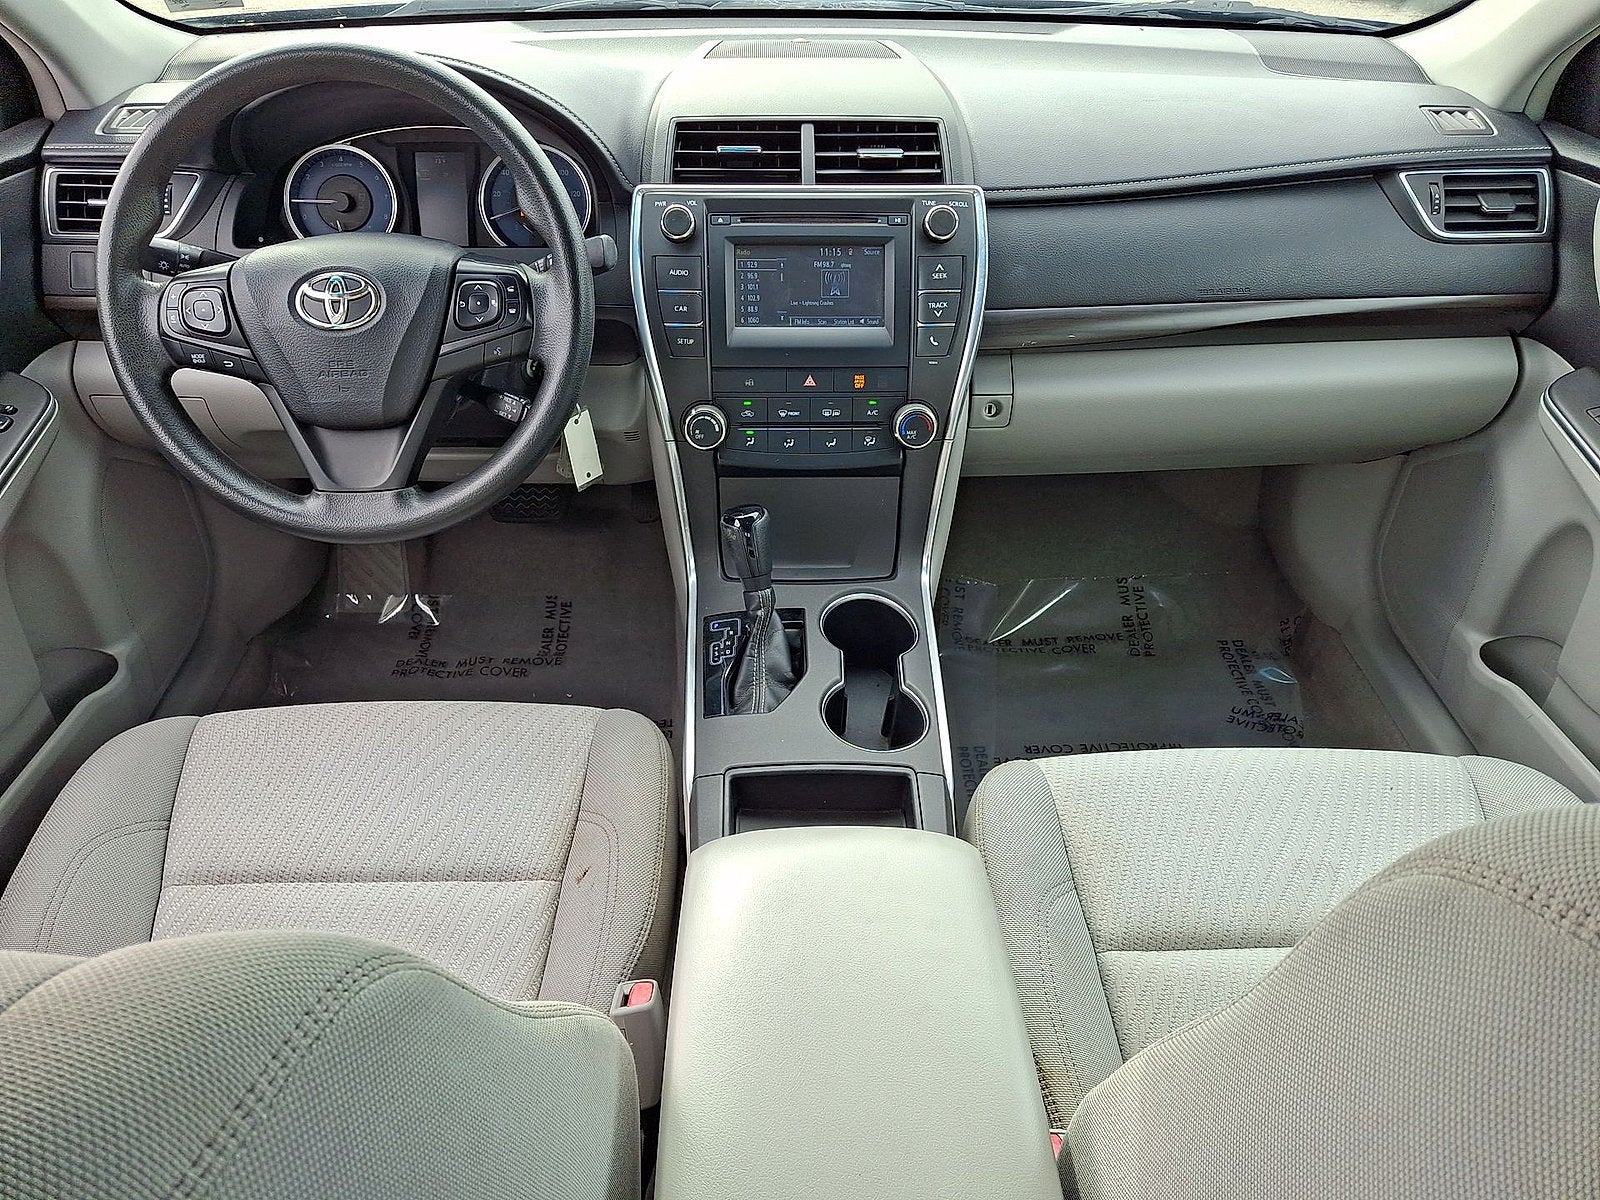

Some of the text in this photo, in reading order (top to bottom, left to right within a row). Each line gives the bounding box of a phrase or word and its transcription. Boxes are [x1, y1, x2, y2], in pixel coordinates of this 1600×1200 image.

[948, 200, 969, 208] SCROLL
[820, 247, 842, 257] 11:15
[863, 248, 880, 256] Source
[932, 272, 948, 280] SEEK
[1132, 585, 1156, 657] PROTECTIVE
[1021, 637, 1058, 647] MUST
[1066, 632, 1124, 644] REMOVE
[1121, 614, 1141, 657] DEALER
[1051, 644, 1097, 655] COVER
[395, 656, 563, 668] DEALER MUST REMOVE
[391, 666, 528, 678] PROTECTIVE COVER
[1023, 744, 1074, 754] COVER
